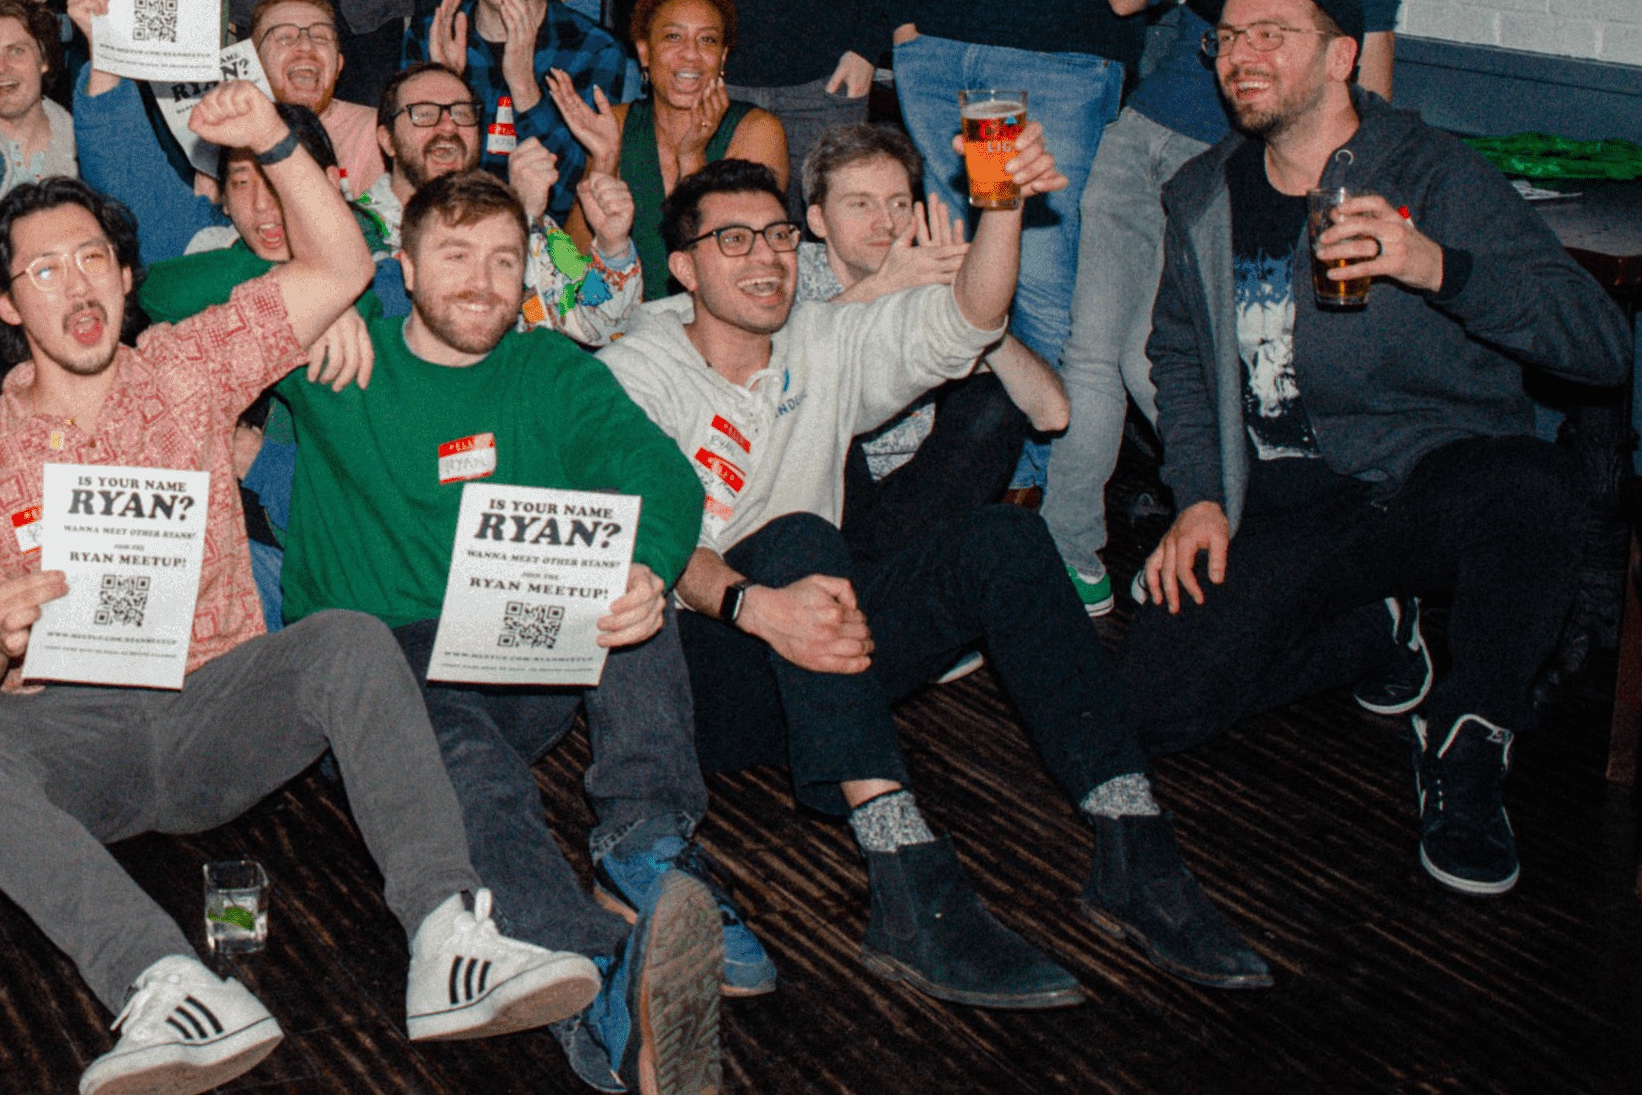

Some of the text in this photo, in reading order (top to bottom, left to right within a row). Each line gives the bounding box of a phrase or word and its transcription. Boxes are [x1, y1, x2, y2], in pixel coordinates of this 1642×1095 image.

[78, 475, 187, 493] IS YOUR NAME
[67, 488, 195, 521] RYAN?
[489, 498, 613, 519] IS YOUR NAME
[64, 524, 99, 534] WANNA
[102, 526, 127, 536] MEET
[129, 528, 160, 538] OTHER
[474, 512, 622, 549] RYAN?
[69, 551, 187, 568] RYAN MEETUP!
[467, 549, 507, 561] WANNA
[510, 554, 539, 564] MEET
[542, 556, 578, 567] OTHER
[469, 576, 609, 600] RYAN MEETUP!
